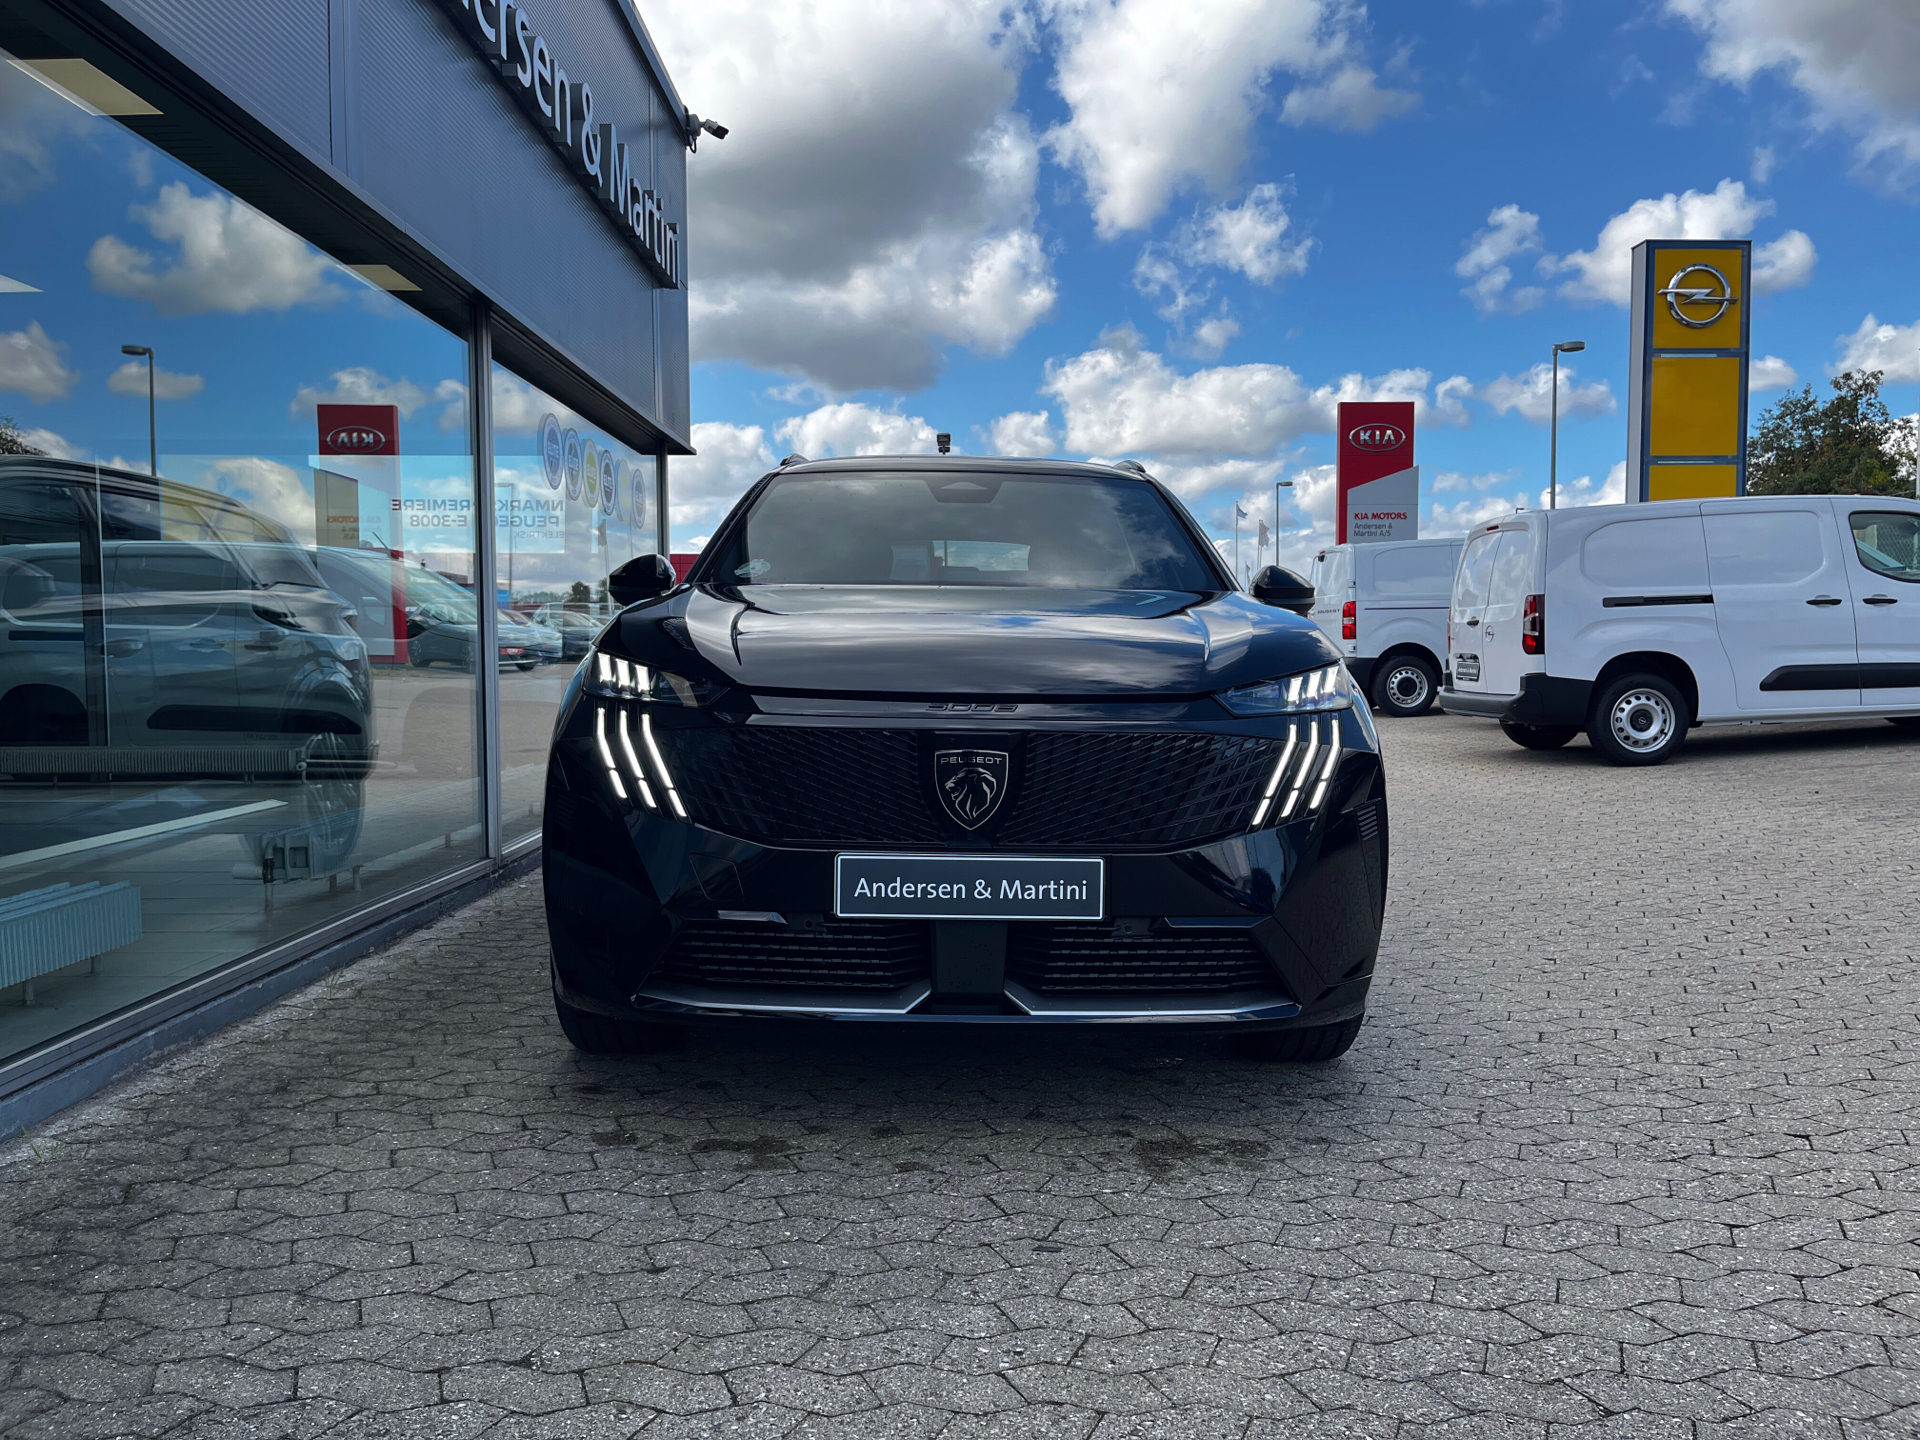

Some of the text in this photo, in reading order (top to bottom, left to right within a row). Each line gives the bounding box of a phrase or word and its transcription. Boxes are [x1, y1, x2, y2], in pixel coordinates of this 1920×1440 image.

[581, 83, 603, 187] &
[610, 123, 679, 290] Martini
[1359, 429, 1396, 445] KIA
[1354, 512, 1408, 520] KIA MOTORS
[1354, 522, 1385, 530] Andersen
[1353, 529, 1392, 538] Martini A/S
[925, 703, 1019, 713] 3008
[940, 756, 1003, 765] PEUGEOT
[854, 876, 1088, 900] Andersen & Martini
